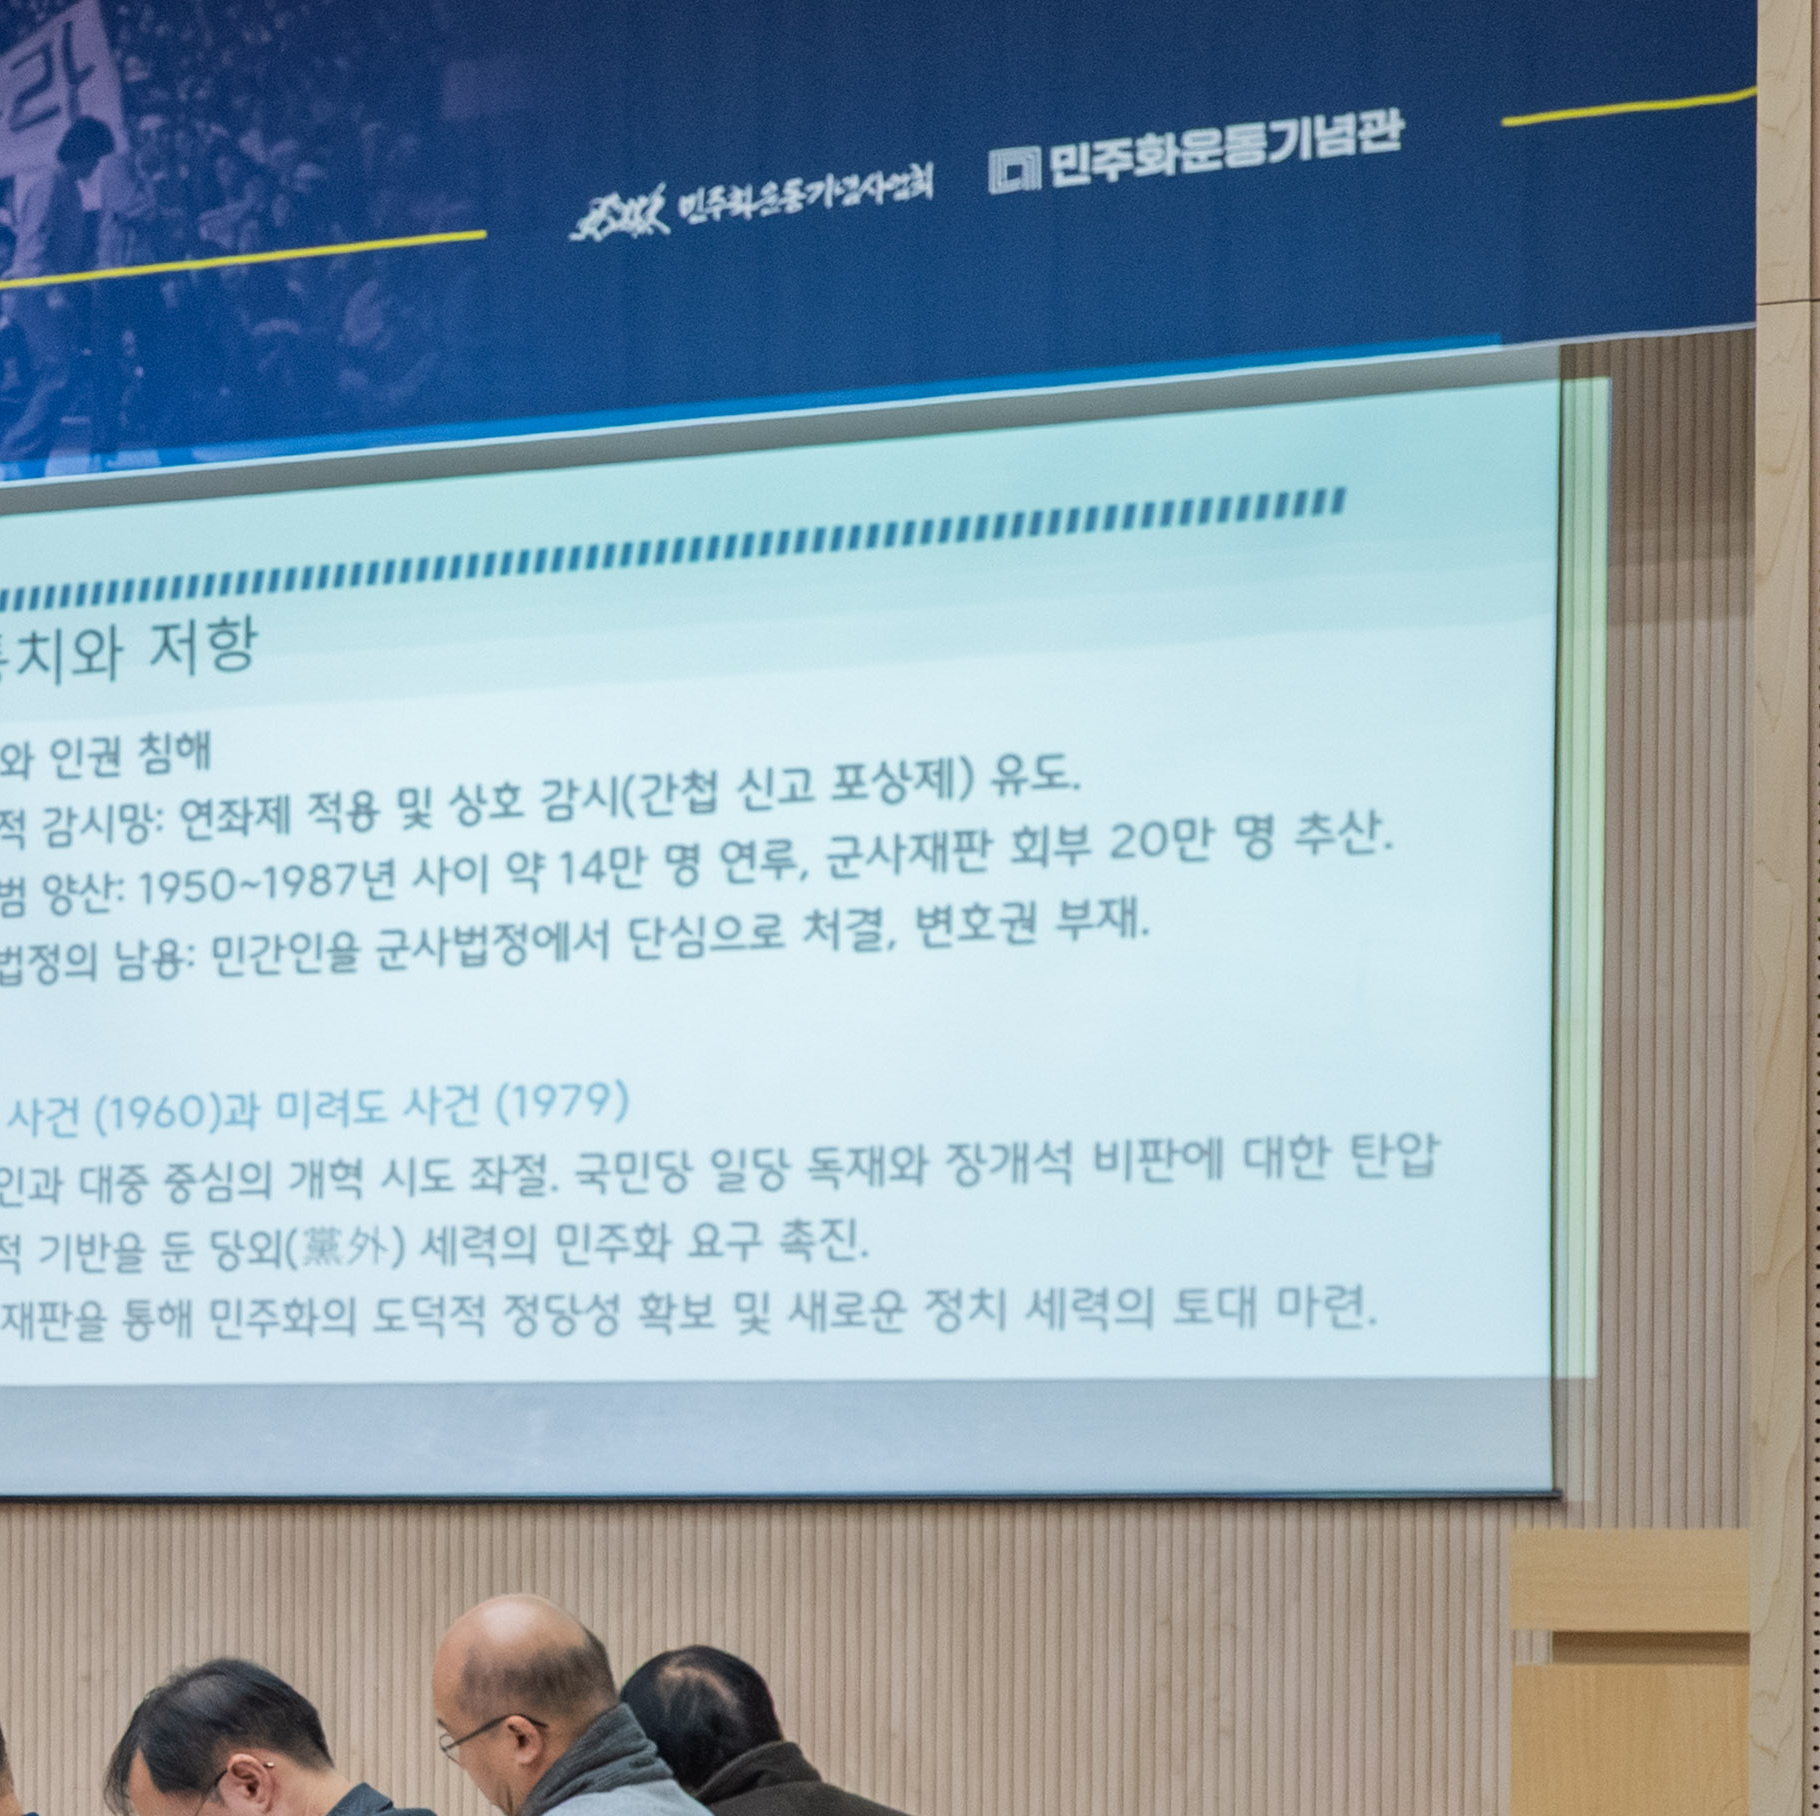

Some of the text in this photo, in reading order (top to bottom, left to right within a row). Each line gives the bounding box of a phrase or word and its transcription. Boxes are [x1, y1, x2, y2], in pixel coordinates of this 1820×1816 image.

[1049, 107, 1407, 189] 민주화운동기념관
[678, 161, 935, 224] 민주화운동기념사업회
[149, 612, 260, 678] 저항
[48, 734, 122, 782] 인권
[137, 729, 212, 777] 침해
[42, 801, 164, 850] 감시망:
[178, 793, 292, 843] 연좌제
[306, 788, 382, 835] 적용
[396, 785, 433, 832] 및
[447, 780, 526, 829] 상호
[540, 768, 719, 824] 감시(간첩
[736, 765, 817, 814] 신고
[830, 754, 976, 807] 포상제)
[989, 751, 1082, 799] 유도.
[41, 871, 125, 918] 양산:
[138, 857, 396, 906] 1950~1987년
[411, 852, 489, 898] 사이
[504, 849, 547, 896] 약
[558, 844, 650, 892] 14만
[663, 841, 702, 890] 명
[718, 837, 810, 886] 연루,
[825, 827, 995, 881] 군사재판
[1009, 823, 1093, 870] 회부
[1109, 816, 1218, 865] 20만
[1233, 812, 1275, 863] 명
[1294, 808, 1394, 857] 추산.
[114, 936, 196, 983] 남용:
[210, 929, 362, 979] 민간인을
[374, 917, 610, 973] 군사법정에서
[627, 912, 787, 963] 단심으로
[802, 905, 897, 955] 처결,
[914, 899, 1038, 951] 변호권
[1054, 894, 1150, 943] 부재.
[6, 1096, 80, 1140] 사건
[94, 1090, 263, 1139] (1960)과
[275, 1087, 389, 1131] 미려도
[402, 1083, 480, 1129] 사건
[494, 1077, 631, 1128] (1979)
[78, 1162, 151, 1207] 대중
[162, 1159, 273, 1207] 중심의
[288, 1156, 364, 1202] 개혁
[380, 1155, 456, 1199] 시도
[469, 1152, 560, 1199] 좌절.
[573, 1148, 695, 1197] 국민당
[709, 1146, 793, 1195] 일당
[805, 1142, 931, 1192] 독재와
[944, 1139, 1074, 1190] 장개석
[1093, 1135, 1225, 1185] 비판에
[1242, 1132, 1333, 1182] 대한
[1350, 1131, 1442, 1181] 탄압
[38, 1230, 147, 1276] 기반을
[159, 1230, 196, 1274] 둔
[208, 1224, 407, 1274] 당외(黨外)
[418, 1223, 538, 1270] 세력의
[554, 1220, 674, 1268] 민주화
[686, 1220, 765, 1264] 요구
[778, 1216, 870, 1264] 촉진.
[0, 1298, 109, 1344] 재판을
[120, 1298, 194, 1343] 통해
[208, 1295, 357, 1342] 민주화의
[372, 1294, 486, 1340] 도덕적
[503, 1291, 621, 1340] 정당성
[637, 1290, 717, 1337] 확보
[732, 1289, 771, 1337] 및
[786, 1288, 909, 1335] 새로운
[924, 1286, 1007, 1336] 정치
[1024, 1285, 1155, 1334] 세력의
[1172, 1284, 1258, 1330] 토대
[1276, 1283, 1378, 1331] 마련.
